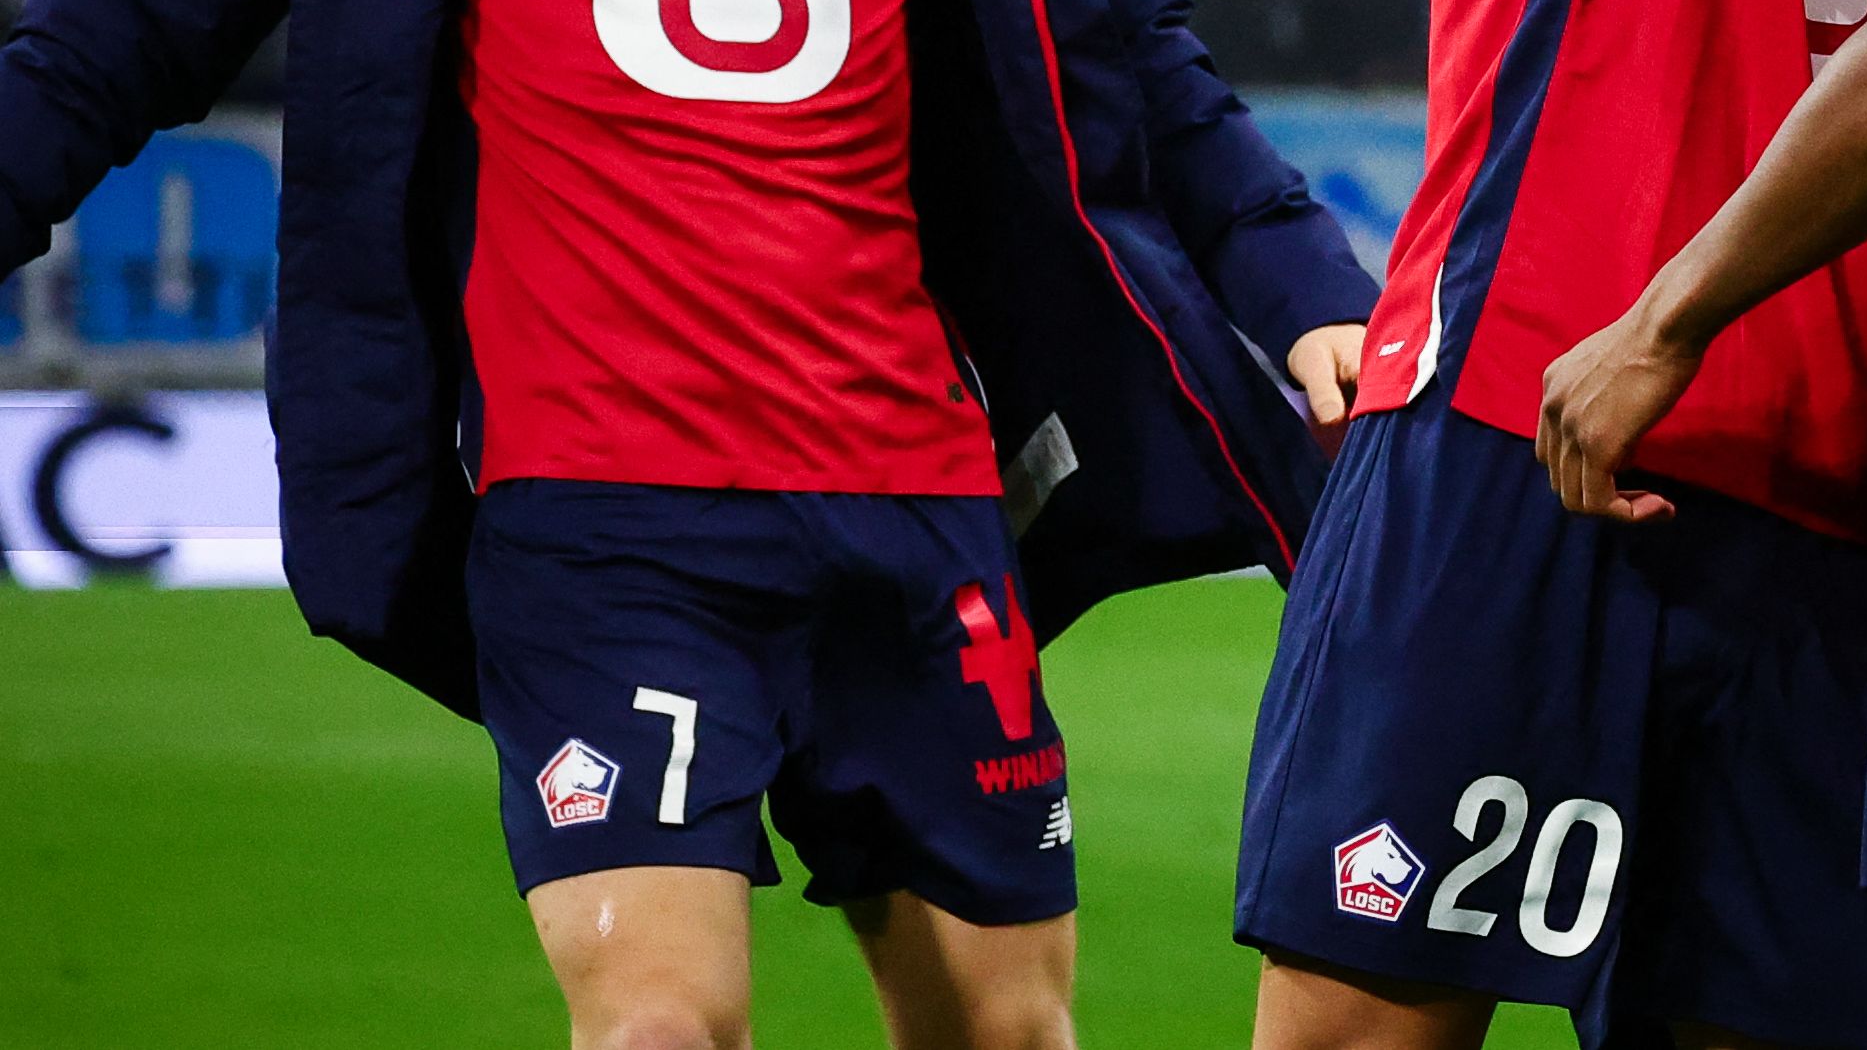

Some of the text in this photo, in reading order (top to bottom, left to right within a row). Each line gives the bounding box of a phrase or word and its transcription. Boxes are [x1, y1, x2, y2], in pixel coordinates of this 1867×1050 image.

[632, 686, 698, 825] 7
[555, 799, 601, 821] LOSC
[1344, 889, 1396, 915] LOSC
[1427, 775, 1623, 958] 20
